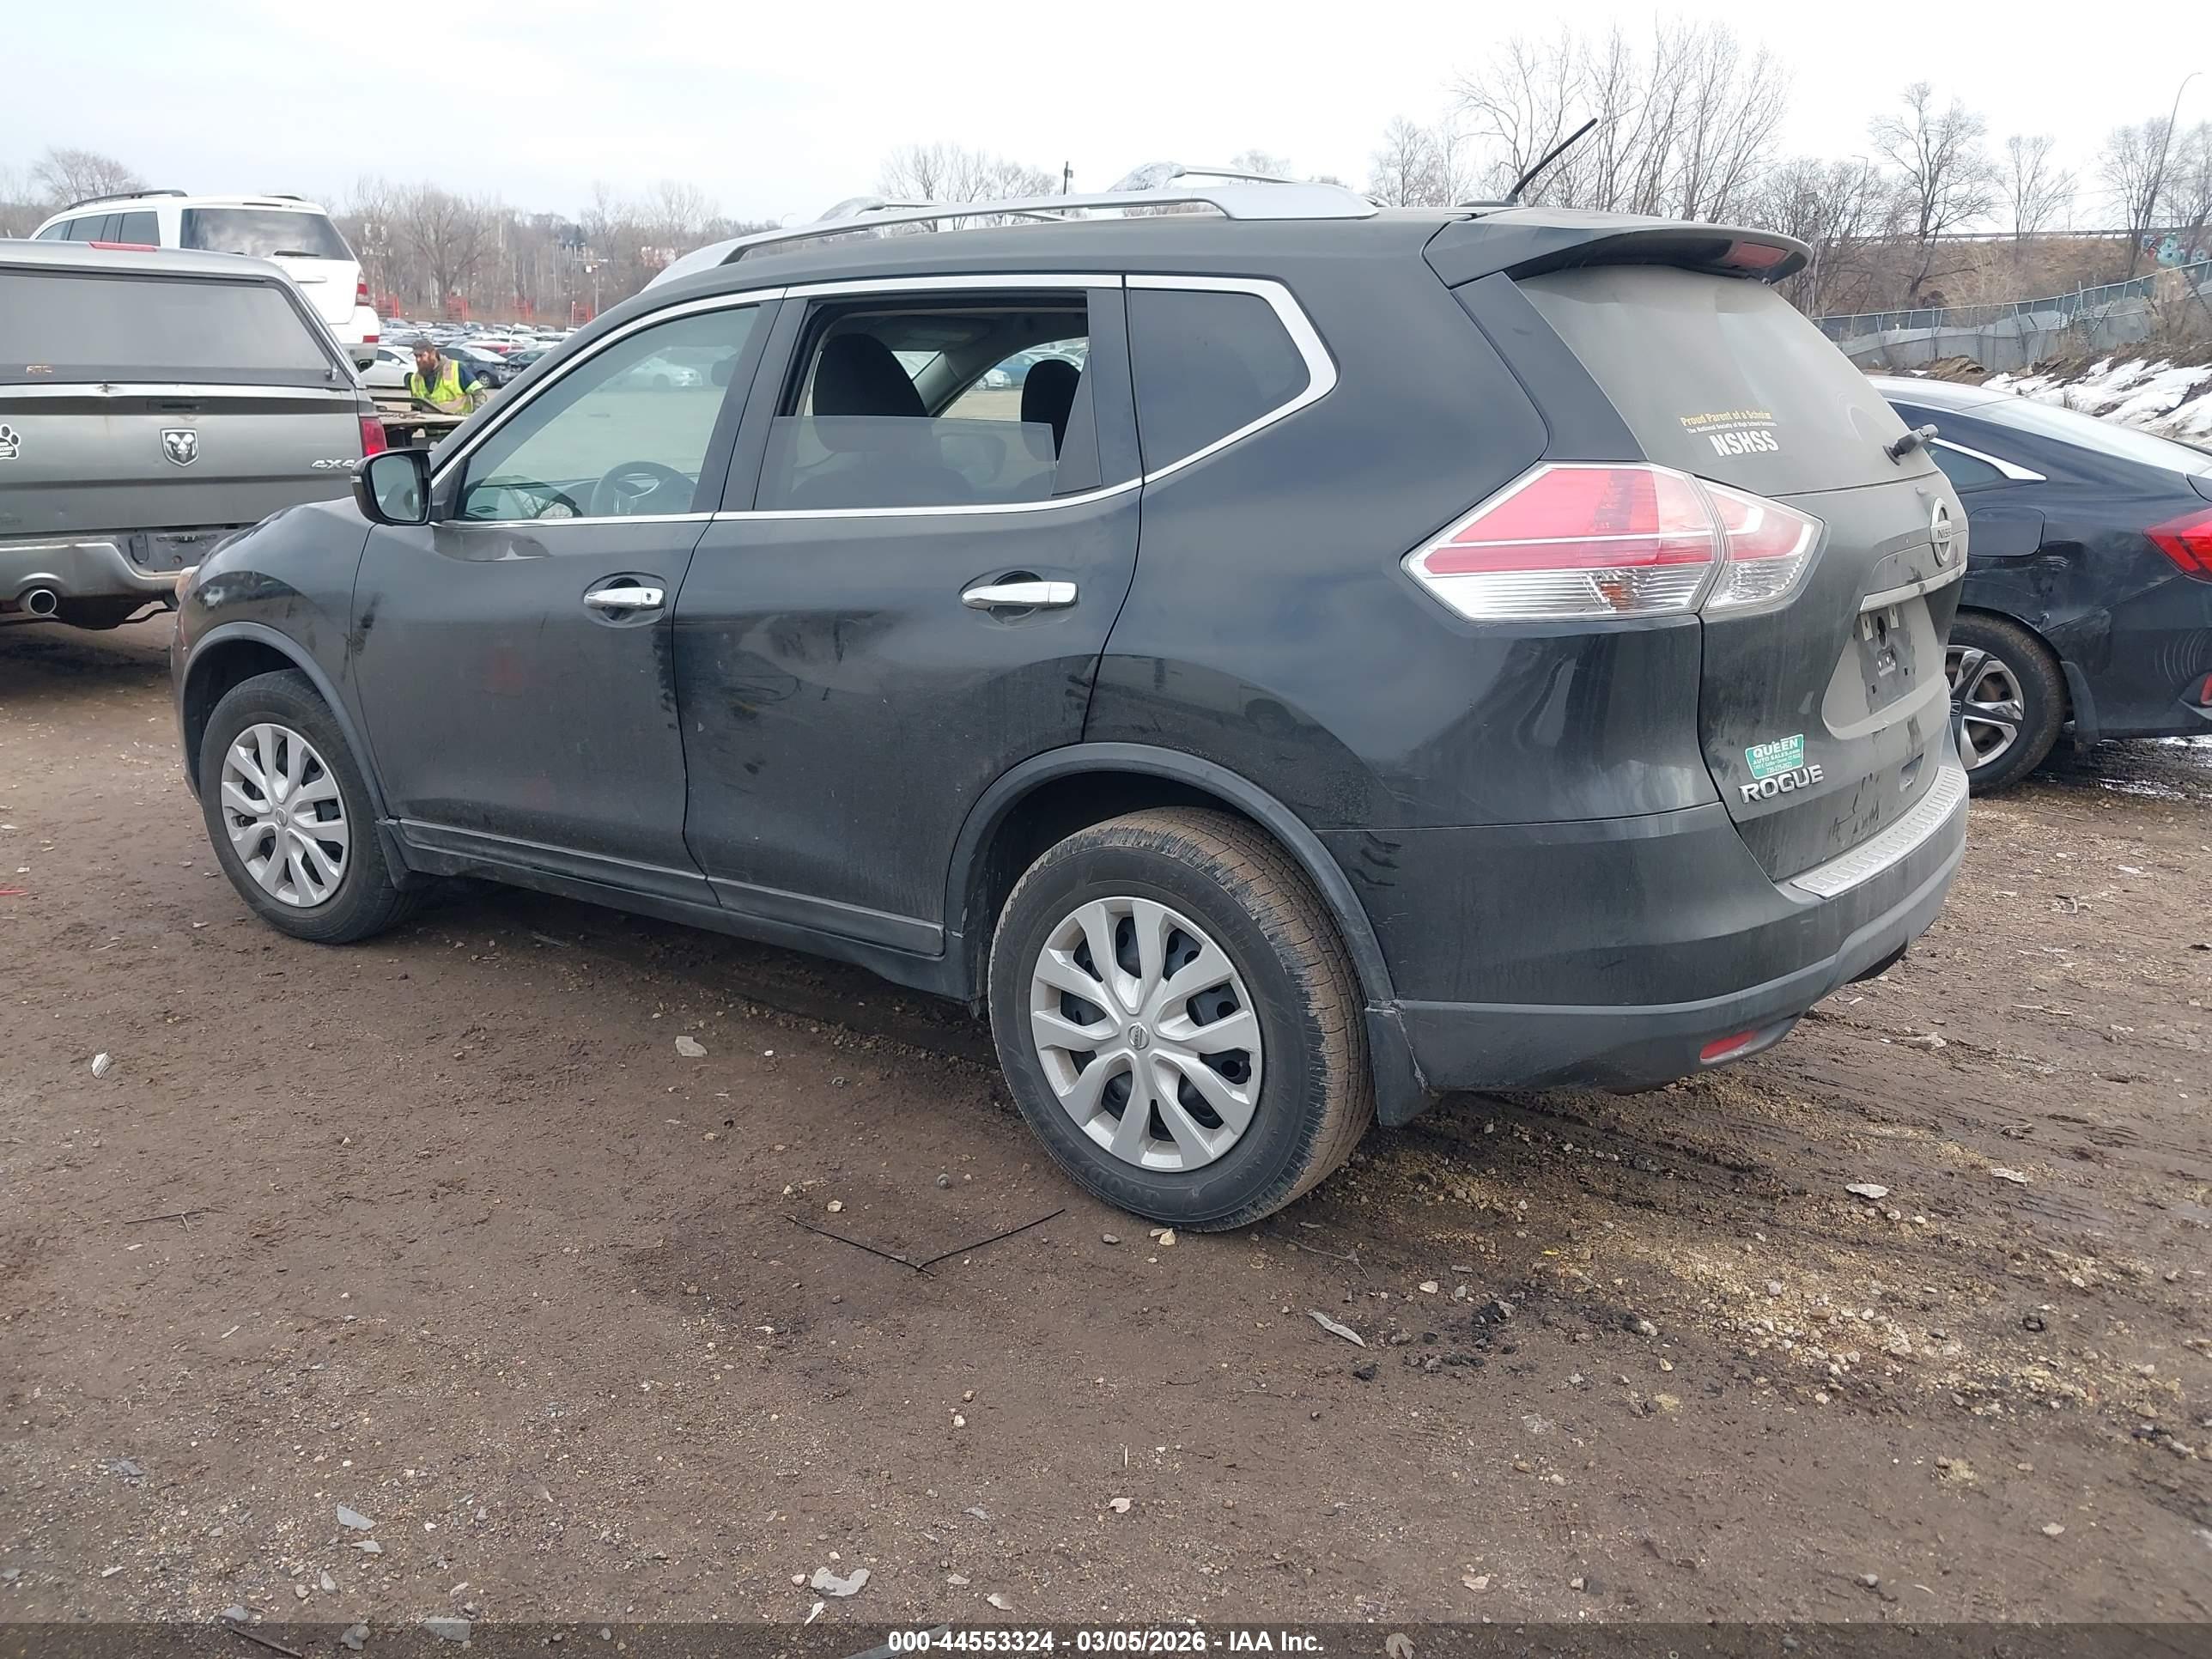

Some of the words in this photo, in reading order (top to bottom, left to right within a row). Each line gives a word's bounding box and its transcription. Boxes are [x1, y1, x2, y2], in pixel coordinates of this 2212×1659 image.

[1680, 414, 1706, 426] Proud
[1705, 411, 1732, 422] Parent
[1733, 410, 1741, 419] of
[1708, 429, 1779, 457] NSHSS
[1937, 527, 1952, 539] NISS
[1753, 738, 1798, 758] QUEEN
[1753, 756, 1770, 765] AUTO
[1737, 763, 1825, 805] ROGUE
